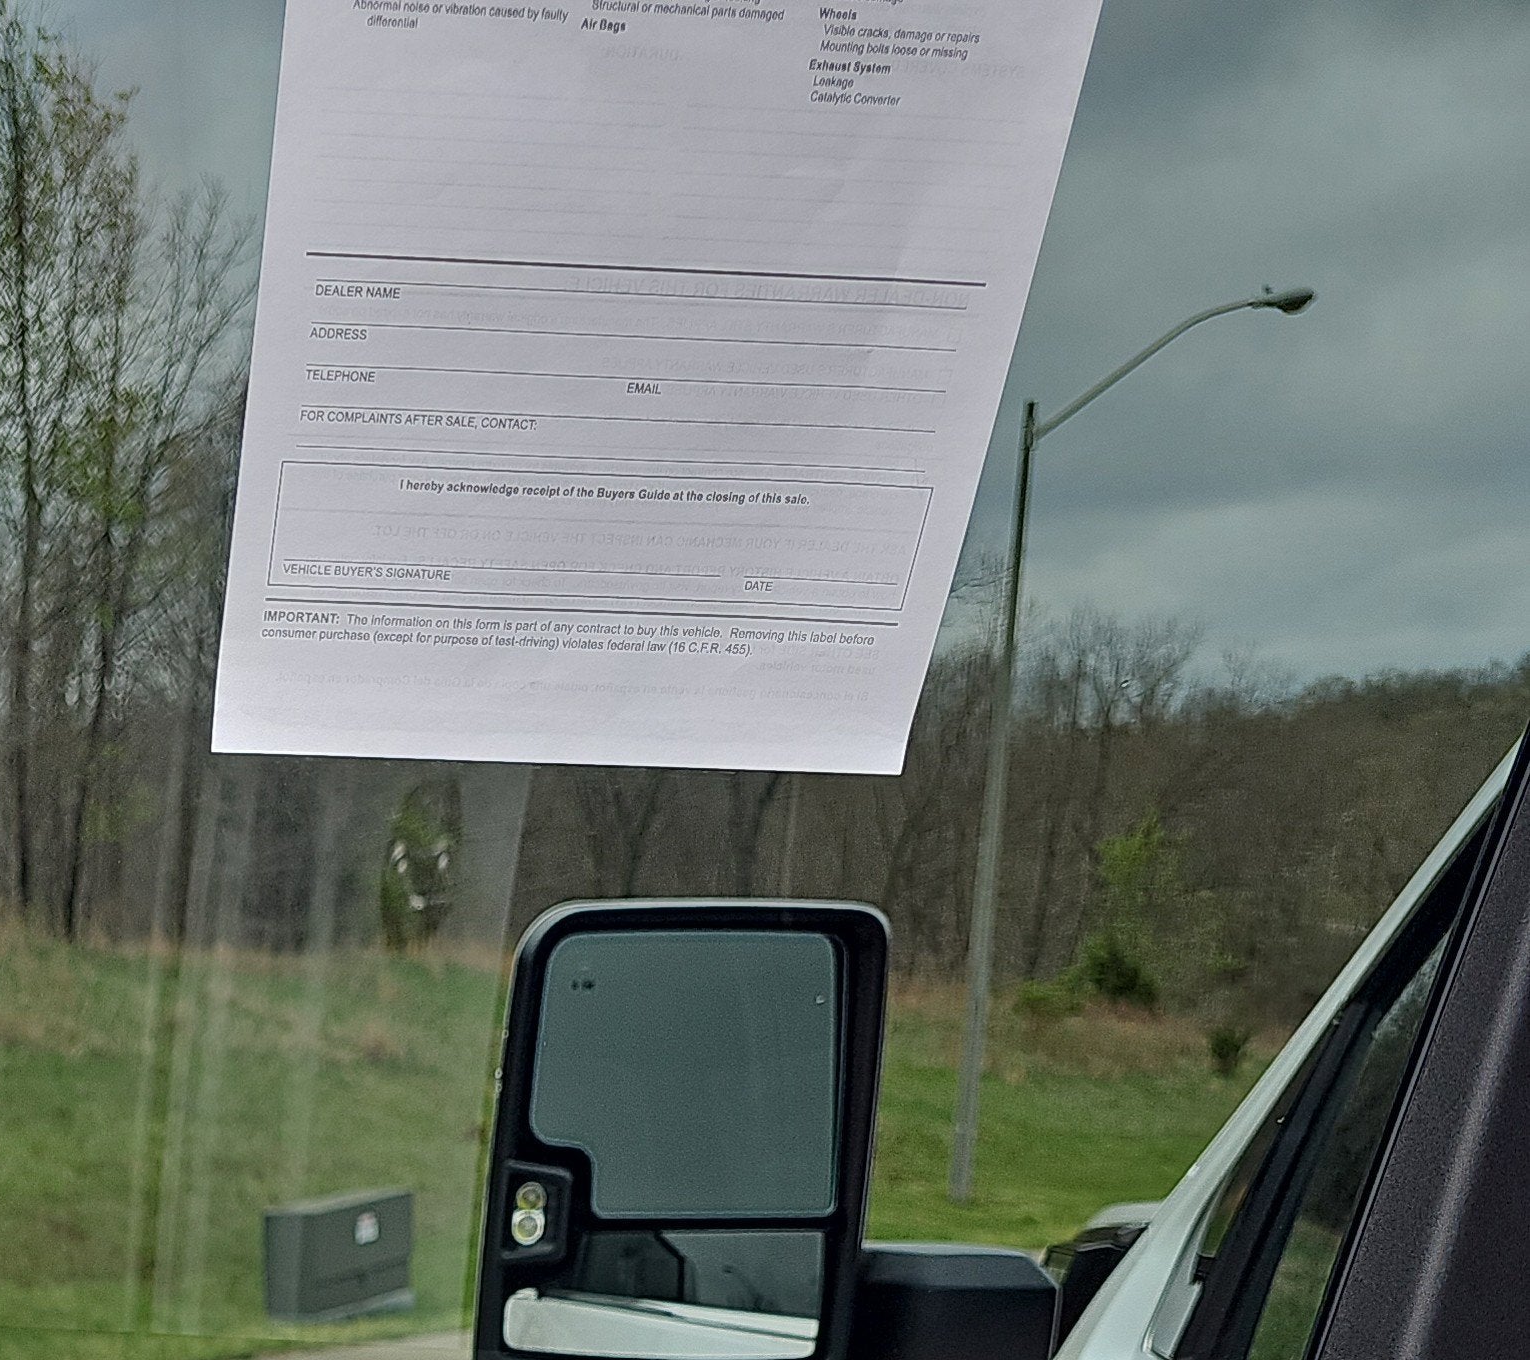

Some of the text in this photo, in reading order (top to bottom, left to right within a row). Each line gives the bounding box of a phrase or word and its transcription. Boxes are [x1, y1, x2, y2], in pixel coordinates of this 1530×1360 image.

[857, 27, 891, 39] cracks,
[315, 284, 400, 299] DEALER NAME
[309, 327, 367, 340] ADDRESS
[306, 369, 375, 382] TELEPHONE
[626, 382, 661, 394] EMAIL
[299, 409, 537, 430] FOR COMPLAINTS AFTER SALE, CONTACT:
[406, 479, 444, 494] hereby
[446, 482, 519, 497] acknowledge
[522, 485, 560, 498] receipt
[562, 486, 575, 496] of
[576, 486, 594, 497] the
[596, 487, 635, 501] Buyers
[638, 488, 670, 500] Guide
[672, 490, 684, 501] at
[686, 490, 703, 501] the
[705, 491, 745, 505] closing
[748, 492, 760, 503] of
[761, 492, 781, 503] this
[784, 493, 809, 504] sale.
[283, 563, 451, 580] VEHICLE BUYER'S SIGNATURE
[744, 580, 773, 591] DATE
[263, 610, 874, 645] IMPORTANT: The information on this form is part of any contract to buy this vehicle. Removing this label before
[261, 628, 317, 638] consumer
[318, 629, 370, 641] purchase
[372, 630, 413, 644] (except
[415, 631, 432, 643] for
[433, 634, 478, 646] purpose
[481, 634, 494, 645] of
[495, 635, 559, 650] test-driving)
[562, 637, 603, 649] violates
[606, 638, 645, 651] federal
[646, 640, 666, 652] law
[668, 640, 686, 655] (16
[724, 643, 755, 657] 455).
